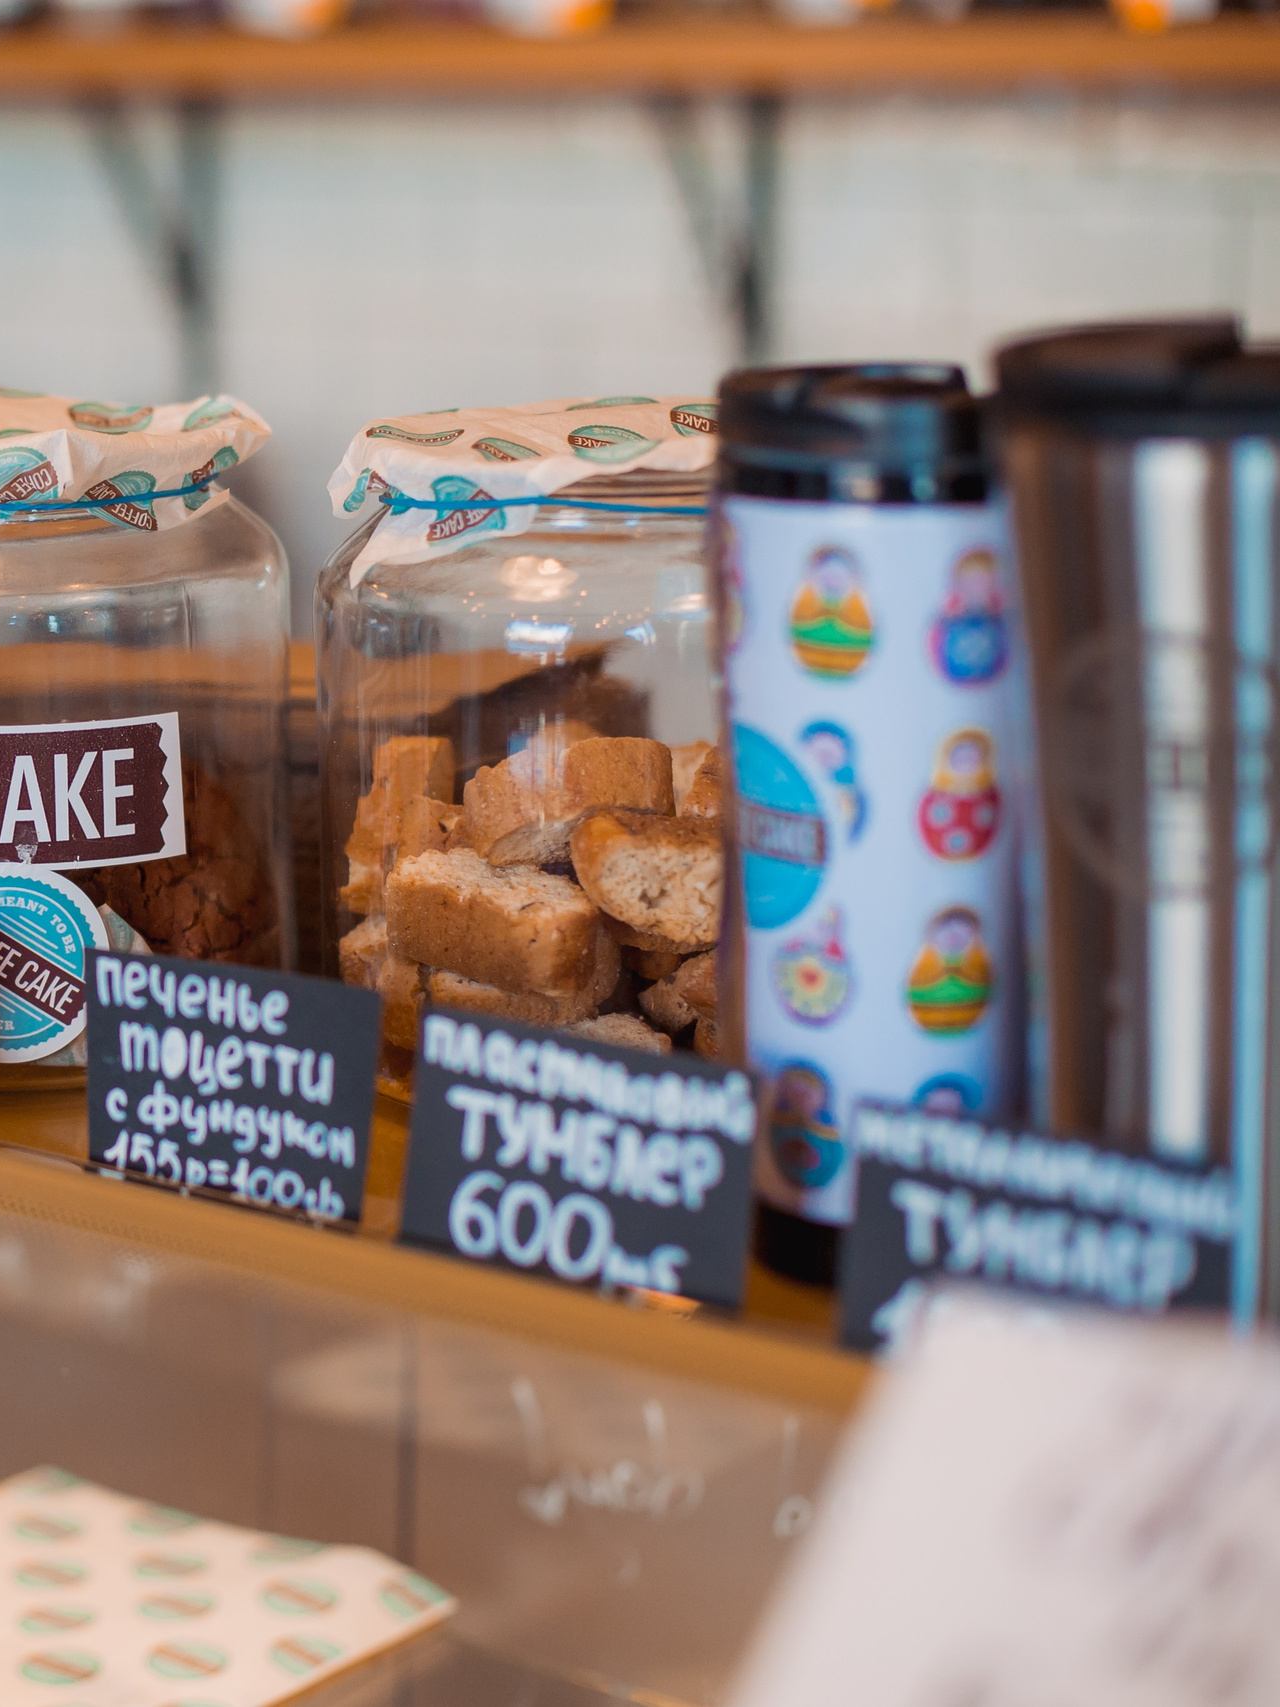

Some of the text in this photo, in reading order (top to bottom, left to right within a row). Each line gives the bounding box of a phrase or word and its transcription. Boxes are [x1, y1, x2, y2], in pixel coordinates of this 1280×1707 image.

[676, 412, 710, 432] CAKE
[50, 914, 68, 935] TO
[62, 933, 77, 955] BE
[14, 960, 81, 1015] CAKE
